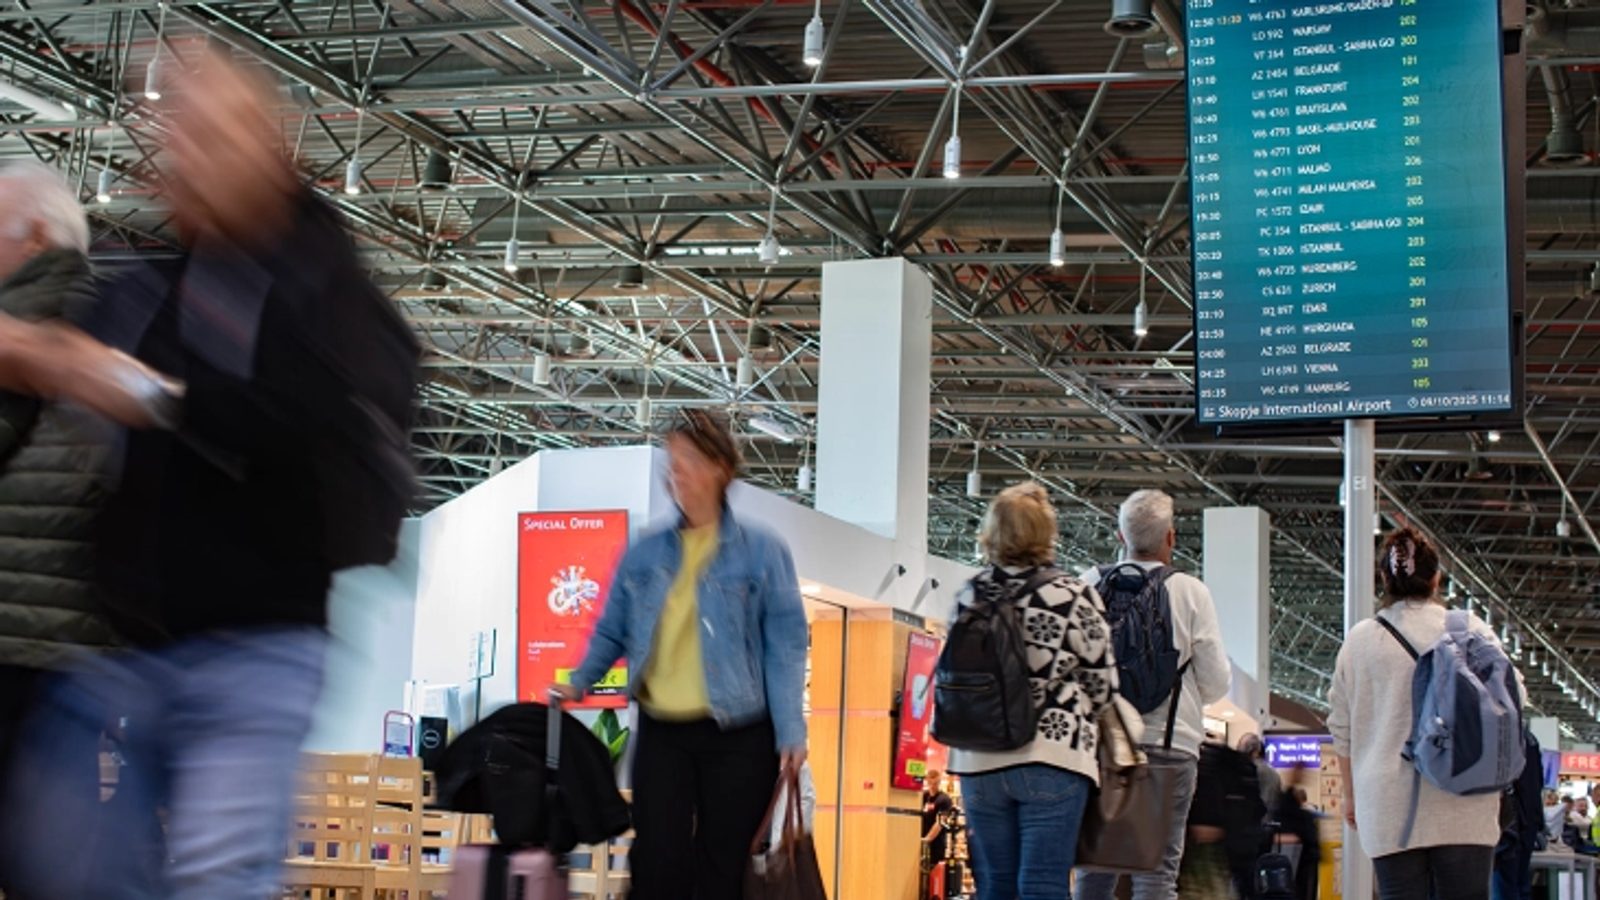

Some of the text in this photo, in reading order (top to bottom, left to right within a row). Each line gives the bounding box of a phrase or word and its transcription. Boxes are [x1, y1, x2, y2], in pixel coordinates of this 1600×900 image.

[1292, 24, 1332, 36] WARSAW
[1293, 44, 1336, 56] ISTANBUL
[1294, 62, 1340, 76] BELGRADE
[1295, 81, 1348, 95] FRANKFURT
[1296, 102, 1347, 115] BRATISLAVA
[1296, 118, 1376, 135] BASEL-MULHOUSE
[1297, 144, 1320, 155] LYON
[1298, 183, 1326, 194] MILAN
[1328, 180, 1376, 192] MALPENSA
[1300, 222, 1342, 234] ISTANBUL
[1300, 242, 1344, 254] ISTANBUL
[1302, 282, 1336, 294] ZURICH
[1303, 322, 1355, 334] HURGHADA
[1304, 342, 1351, 354] BELGRADE
[1304, 363, 1338, 374] VIENNA
[1304, 382, 1350, 394] HAMBURG
[1218, 405, 1259, 420] Skopje
[1264, 400, 1343, 416] International
[1346, 398, 1392, 414] Airport
[524, 517, 604, 531] SPECIAL OFFER
